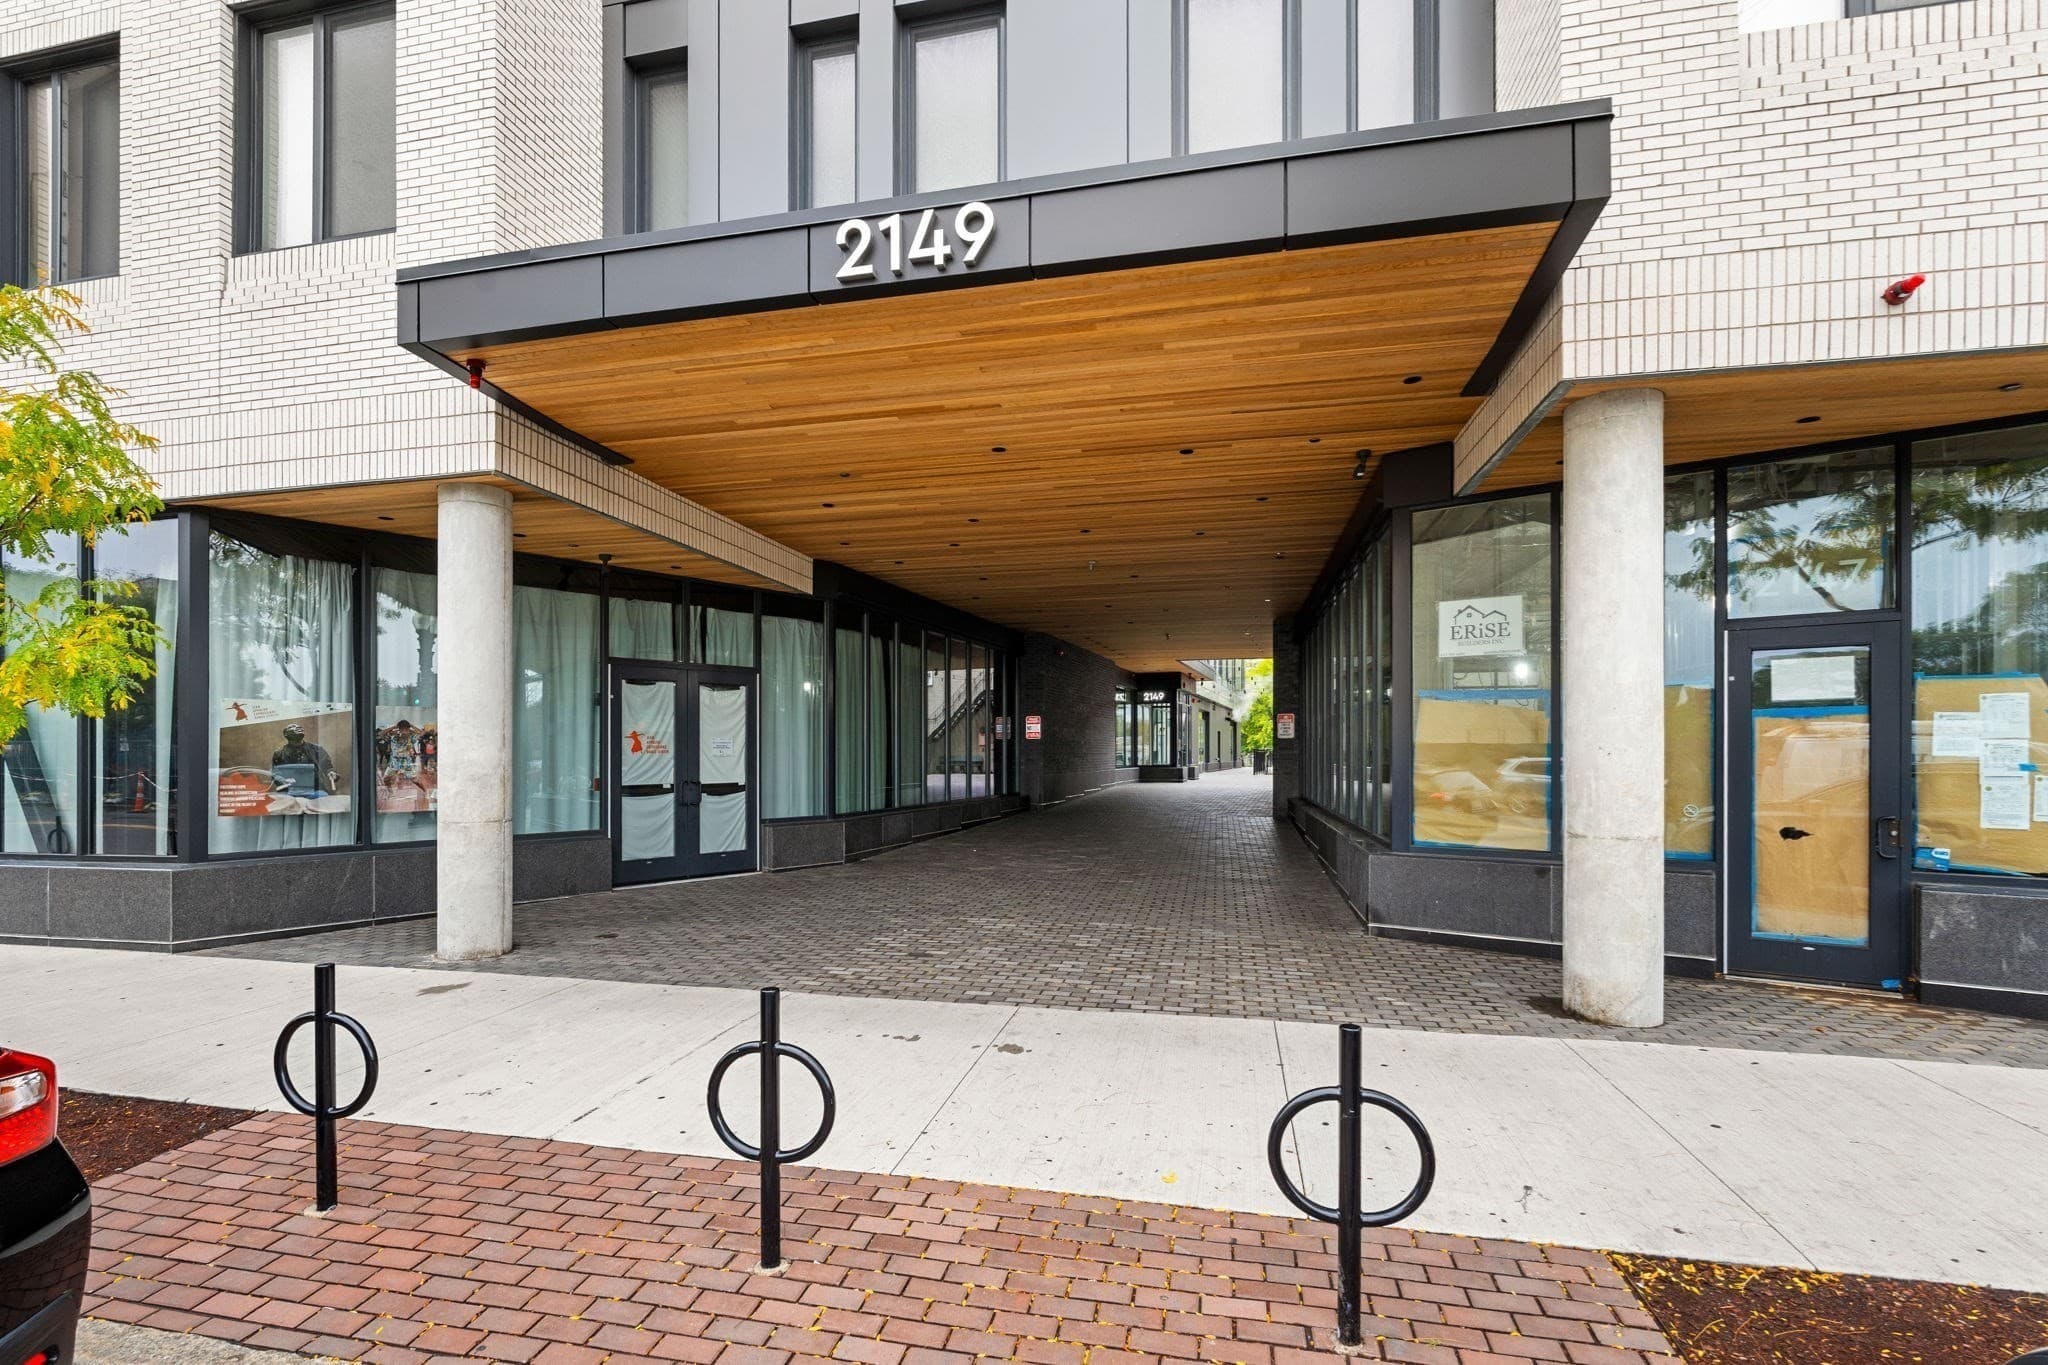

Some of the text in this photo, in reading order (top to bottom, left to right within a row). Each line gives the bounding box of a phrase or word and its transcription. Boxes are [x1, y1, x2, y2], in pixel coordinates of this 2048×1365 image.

[836, 201, 996, 283] 2149
[1450, 621, 1511, 641] ERiSE
[1143, 692, 1165, 701] 2149
